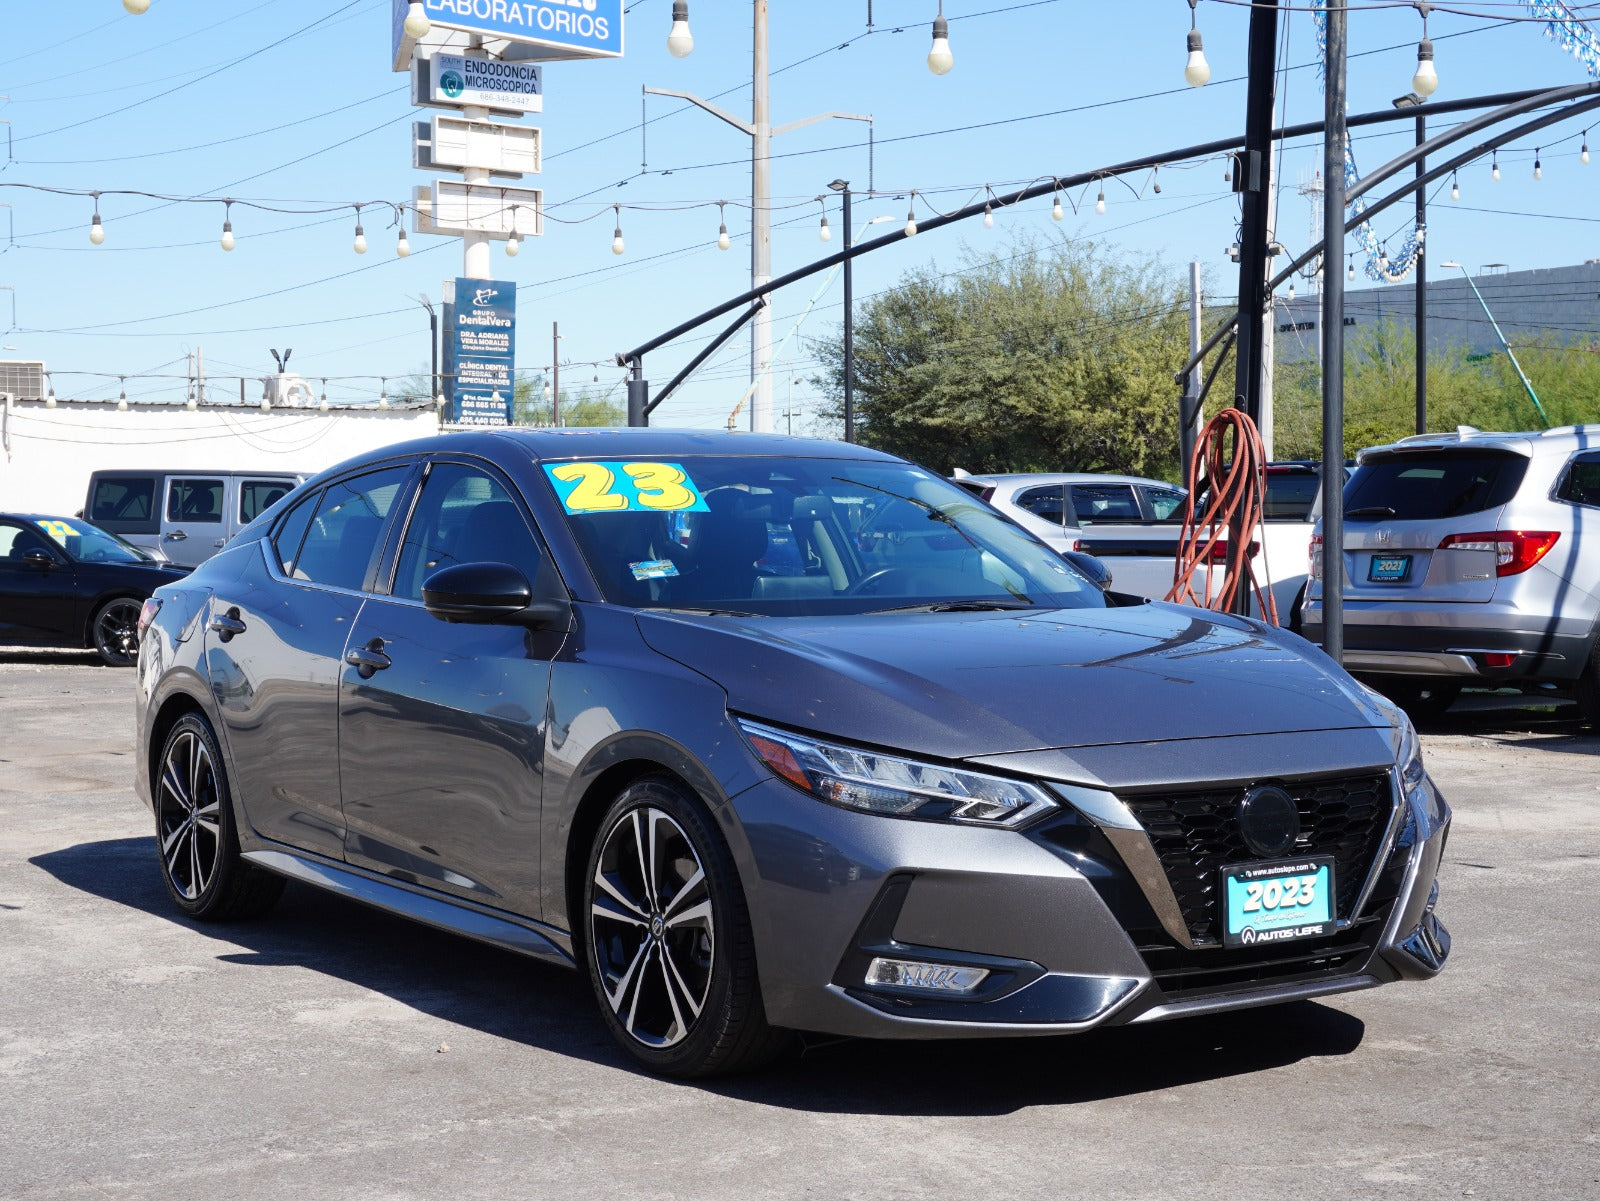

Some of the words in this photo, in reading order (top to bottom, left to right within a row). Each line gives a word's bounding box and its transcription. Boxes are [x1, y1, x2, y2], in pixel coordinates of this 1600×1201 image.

[465, 60, 538, 81] ENDODONCIA
[465, 75, 537, 94] MICROSCOPICA
[459, 314, 511, 327] DentalVera
[478, 332, 509, 340] ADRIANA
[478, 338, 509, 346] MORALES
[459, 361, 485, 369] CLÍNICA
[551, 463, 696, 510] 23
[1378, 560, 1403, 571] 2021
[1243, 875, 1318, 914] 2023
